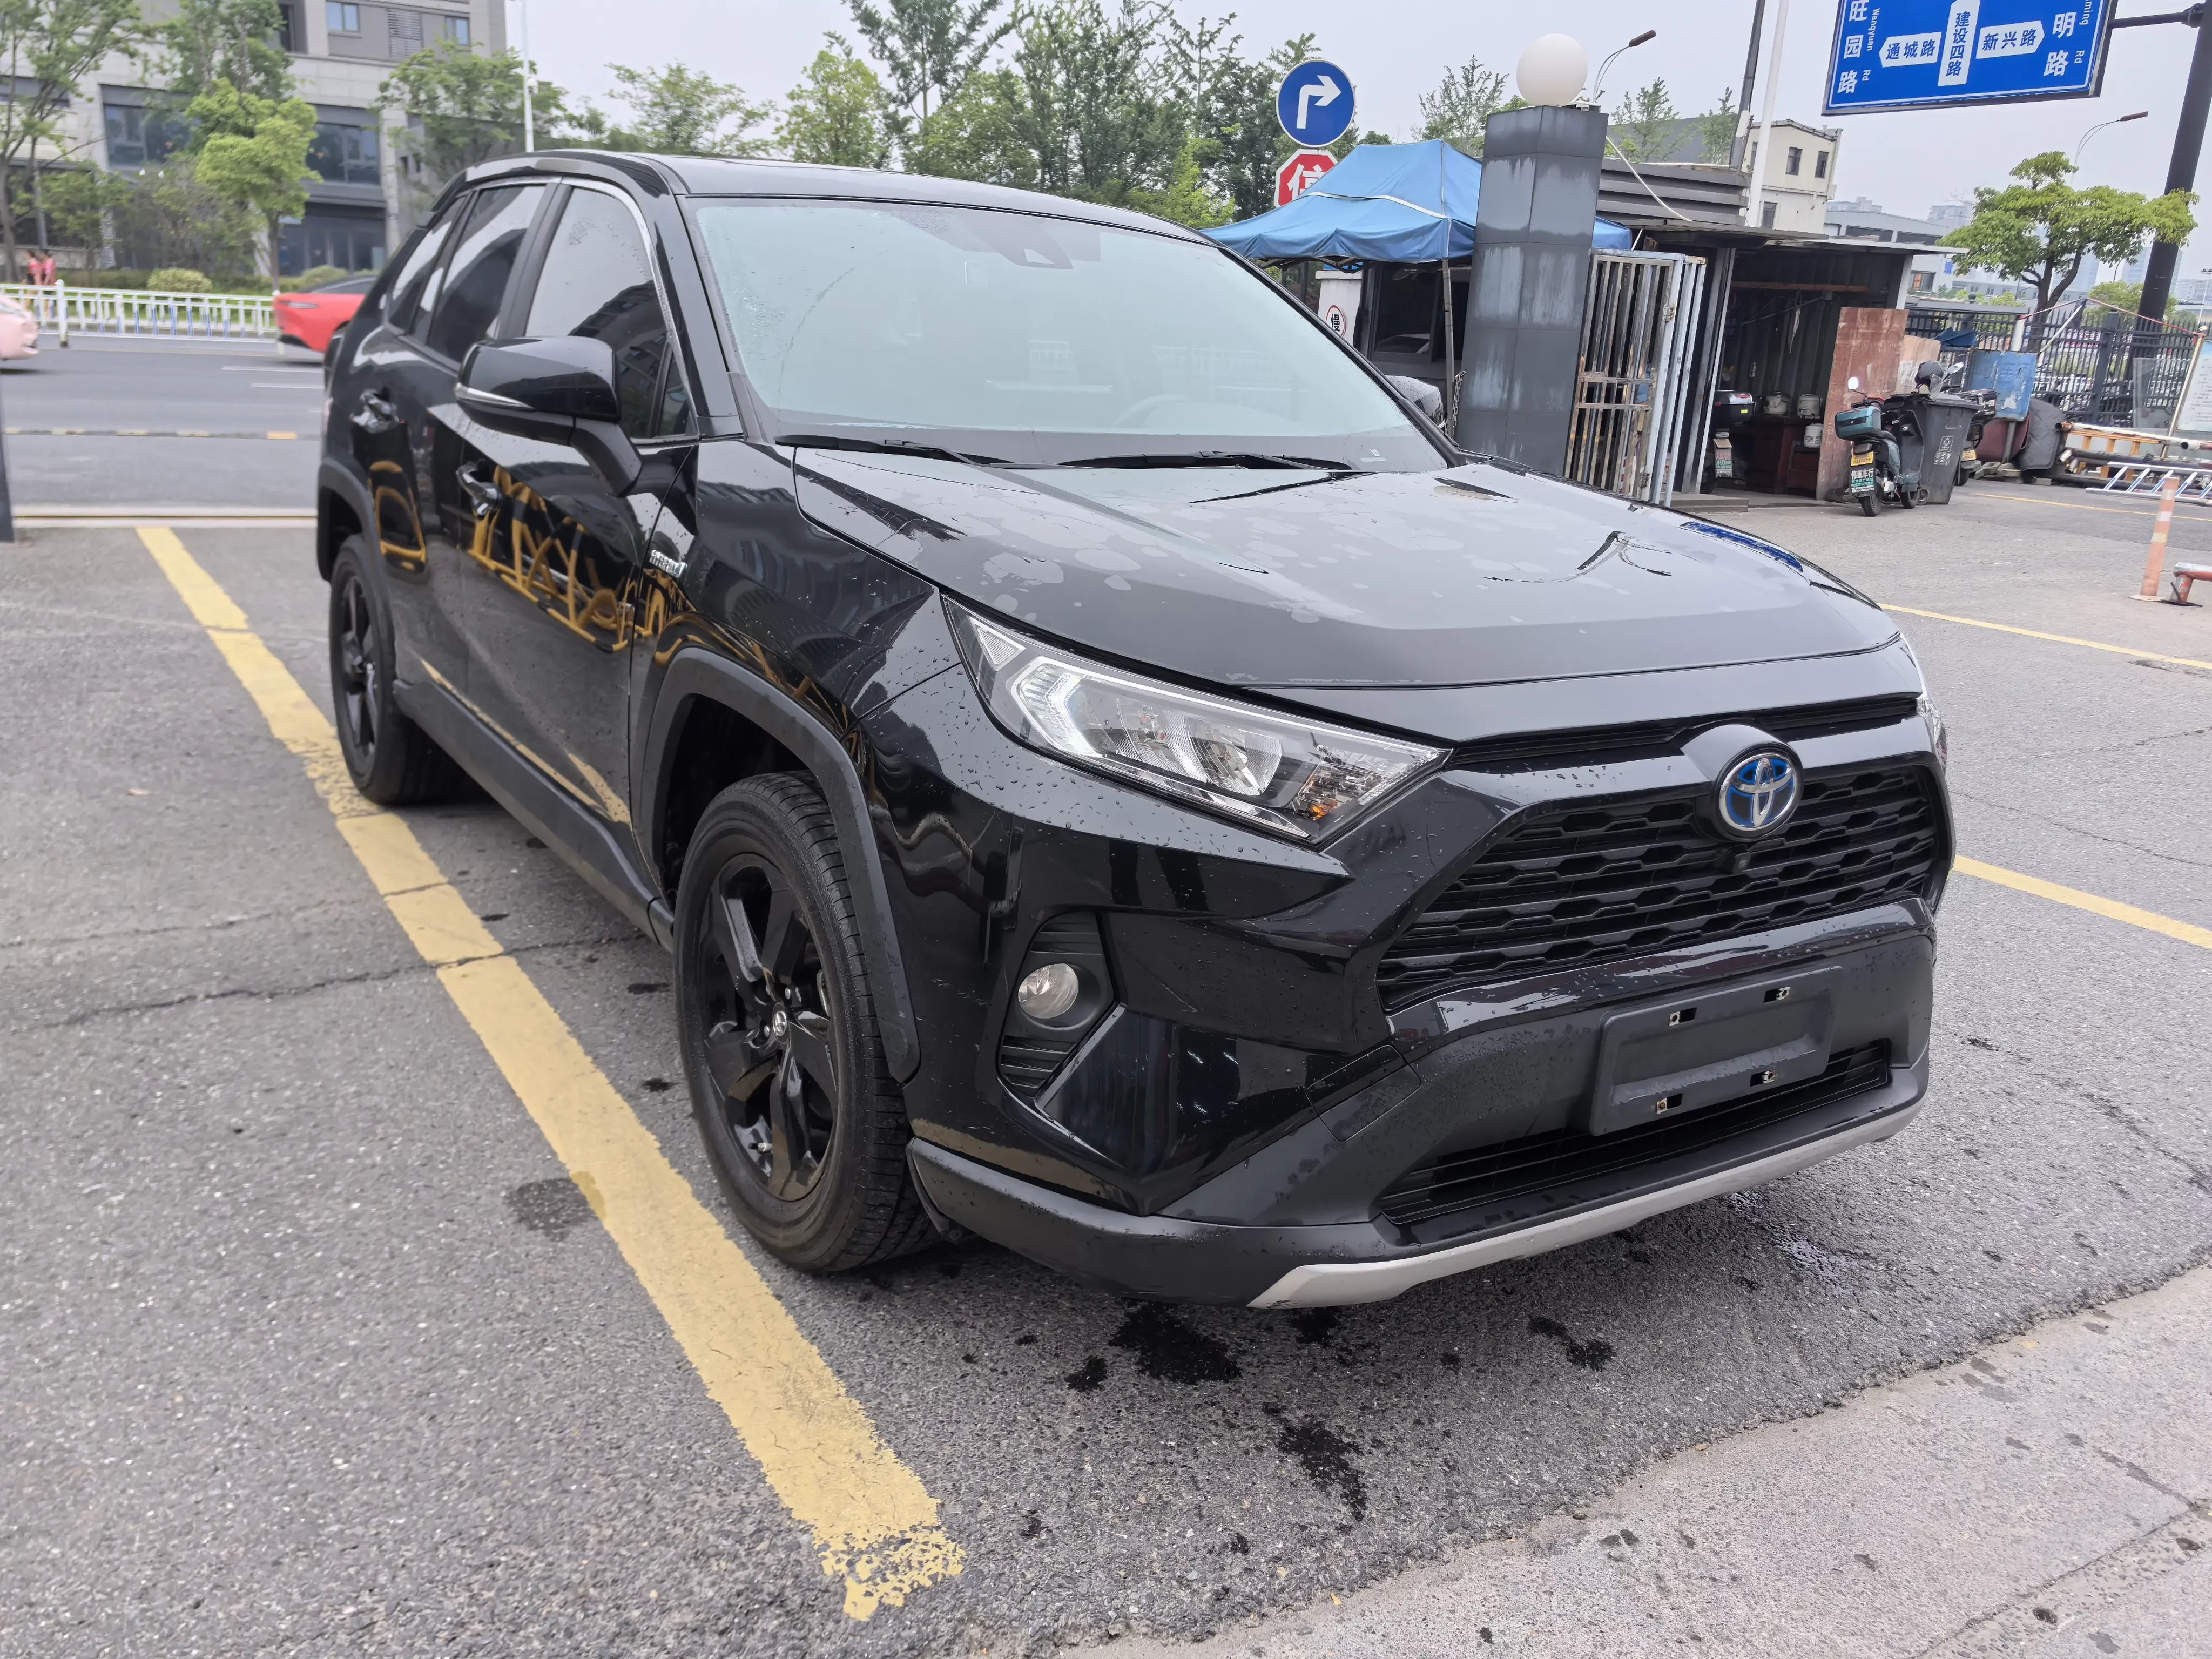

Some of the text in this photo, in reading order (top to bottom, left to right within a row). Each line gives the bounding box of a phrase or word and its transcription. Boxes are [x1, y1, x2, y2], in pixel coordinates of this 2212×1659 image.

[1837, 0, 1869, 94] 旺园路
[1862, 8, 1881, 82] Wangyuan Rd
[1885, 39, 1936, 60] 通城路
[1946, 11, 1971, 76] 建设四路
[1982, 28, 2036, 51] 新兴路
[2043, 11, 2076, 77] 明路
[2074, 0, 2093, 64] ming Rd
[1331, 313, 1340, 332] 慢
